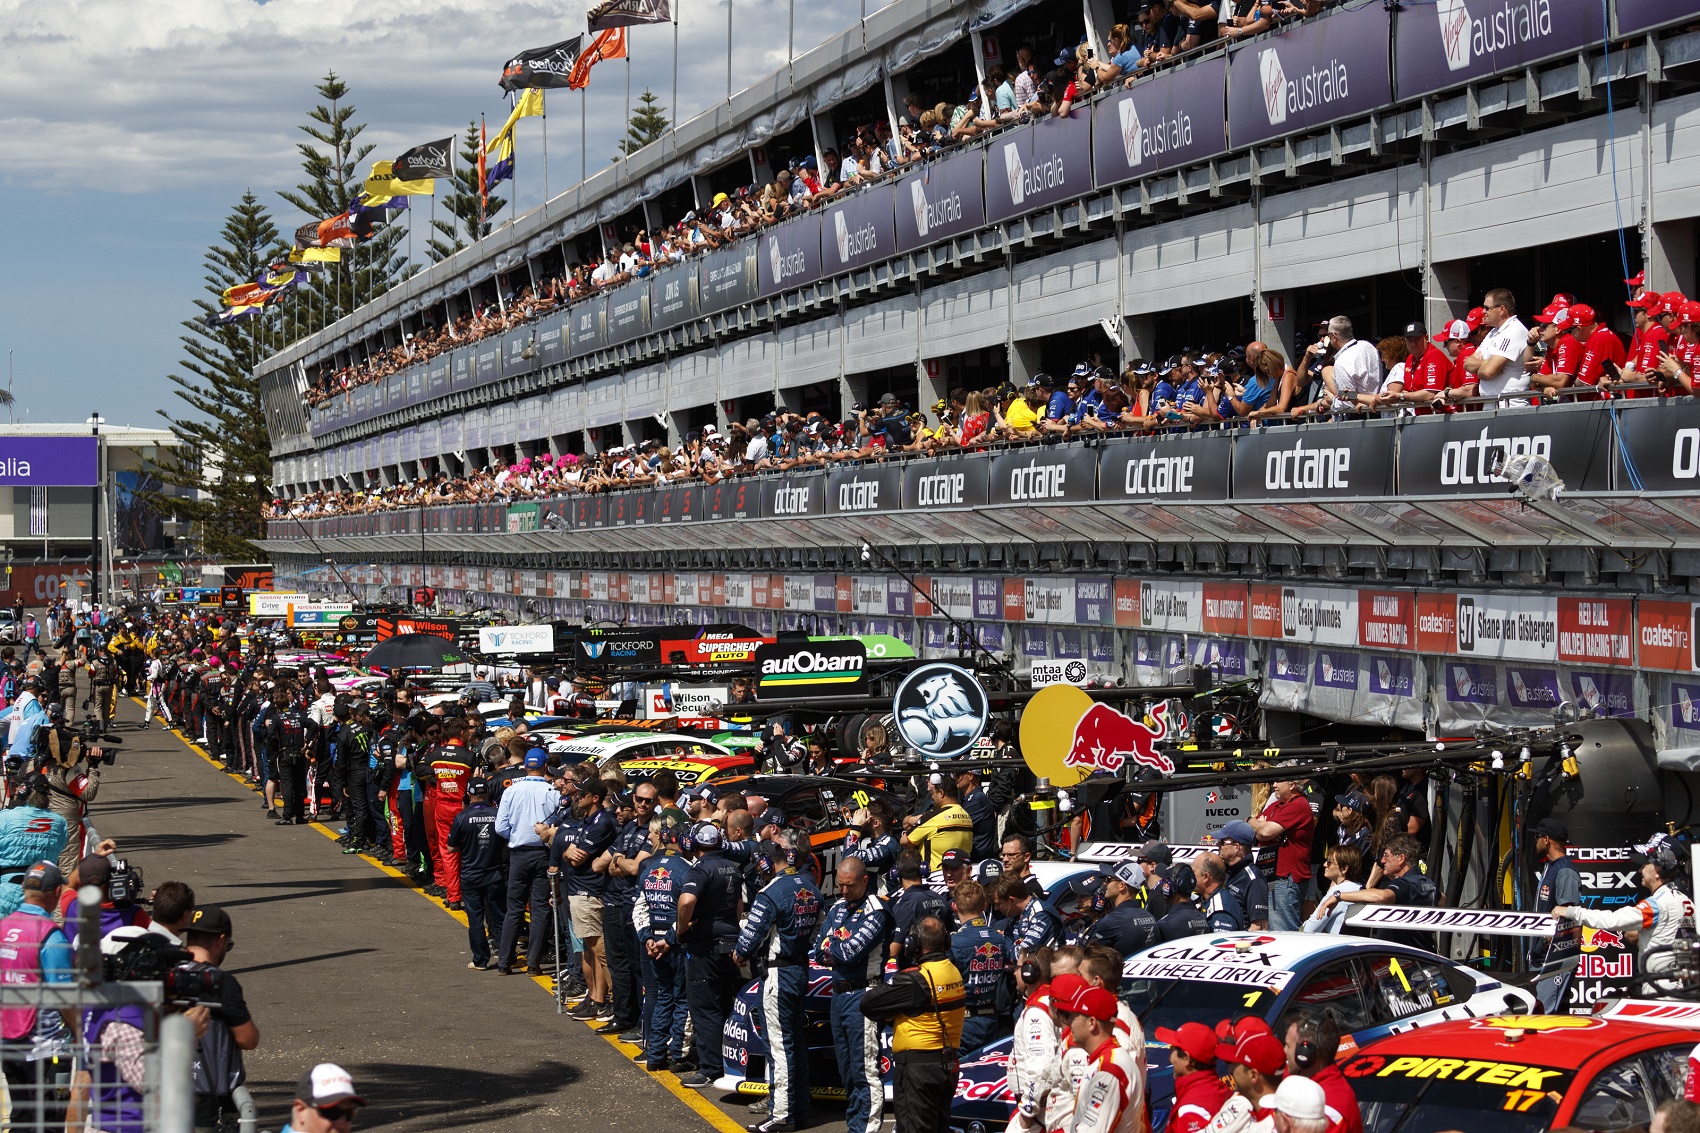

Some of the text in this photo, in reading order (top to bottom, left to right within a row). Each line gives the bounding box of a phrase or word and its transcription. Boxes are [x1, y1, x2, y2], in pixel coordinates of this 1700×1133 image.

[1473, 0, 1552, 56] australia
[1288, 59, 1349, 113] australia
[1142, 110, 1193, 157] australia
[1024, 153, 1065, 197] australia
[928, 192, 962, 229] australia
[848, 222, 877, 257] australia
[781, 248, 806, 278] australia
[1125, 449, 1194, 494] octane
[1265, 438, 1350, 489] octane
[918, 467, 964, 505] octane
[1011, 457, 1066, 500] octane
[774, 481, 809, 514] octane
[839, 475, 879, 510] octane
[1142, 588, 1150, 620] 19
[1154, 595, 1166, 616] Jack
[1252, 602, 1280, 622] coateshire
[1298, 601, 1341, 631] Craig Lowndes
[1579, 602, 1609, 627] RED BULL
[416, 622, 447, 630] Wilson
[1365, 621, 1408, 645] LOWNDES RACING
[1419, 613, 1455, 634] coateshire
[1460, 604, 1473, 644] 97
[1478, 612, 1555, 648] Shane van Gisbergen
[1642, 623, 1688, 649] coateshire
[697, 641, 763, 654] SUPERCHEAP
[1560, 631, 1629, 659] HOLDEN RACING TEAM
[1032, 665, 1061, 674] mtaa
[1032, 674, 1063, 684] super
[674, 693, 710, 702] Wilson
[852, 789, 870, 809] 10
[1206, 808, 1240, 817] IVECO
[645, 892, 673, 903] Holden
[193, 910, 204, 923] P
[1362, 908, 1557, 931] COMMODORE
[1139, 963, 1288, 986] WHEEL DRIVE
[1388, 957, 1412, 993] 1
[1590, 953, 1633, 978] Bull
[1243, 991, 1263, 1008] 1
[1376, 1057, 1564, 1091] PIRTEK
[1503, 1089, 1547, 1112] 17
